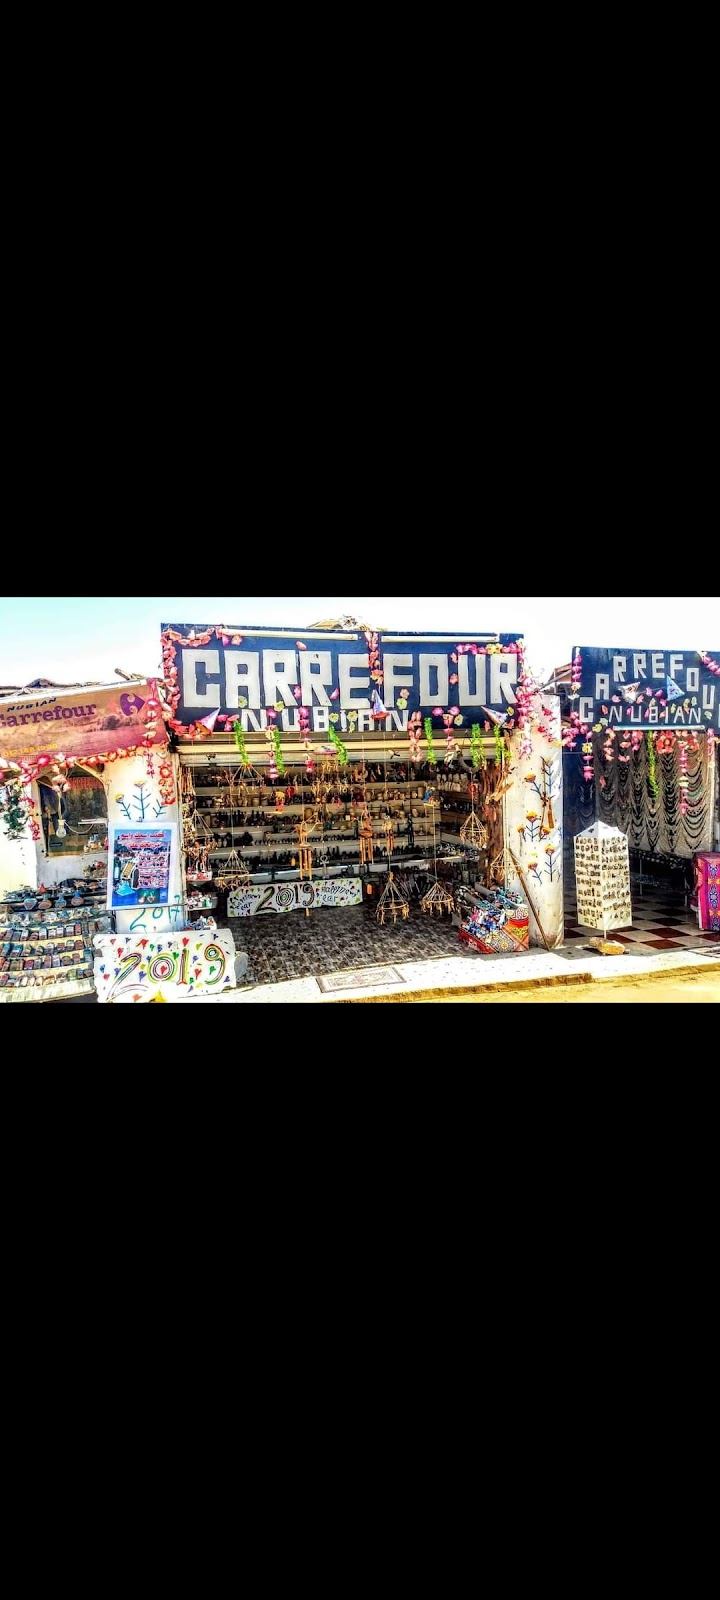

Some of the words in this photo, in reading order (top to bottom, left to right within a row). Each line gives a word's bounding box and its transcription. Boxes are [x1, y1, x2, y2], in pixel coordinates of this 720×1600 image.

[182, 649, 518, 708] CARREFOUR
[580, 653, 720, 728] CARREFOU
[6, 697, 57, 712] NUBIAN
[240, 706, 409, 732] NUBIAN
[608, 706, 701, 724] NUBIAN
[129, 895, 181, 931] 2017
[254, 884, 315, 912] 2019
[106, 944, 225, 1002] 2019
